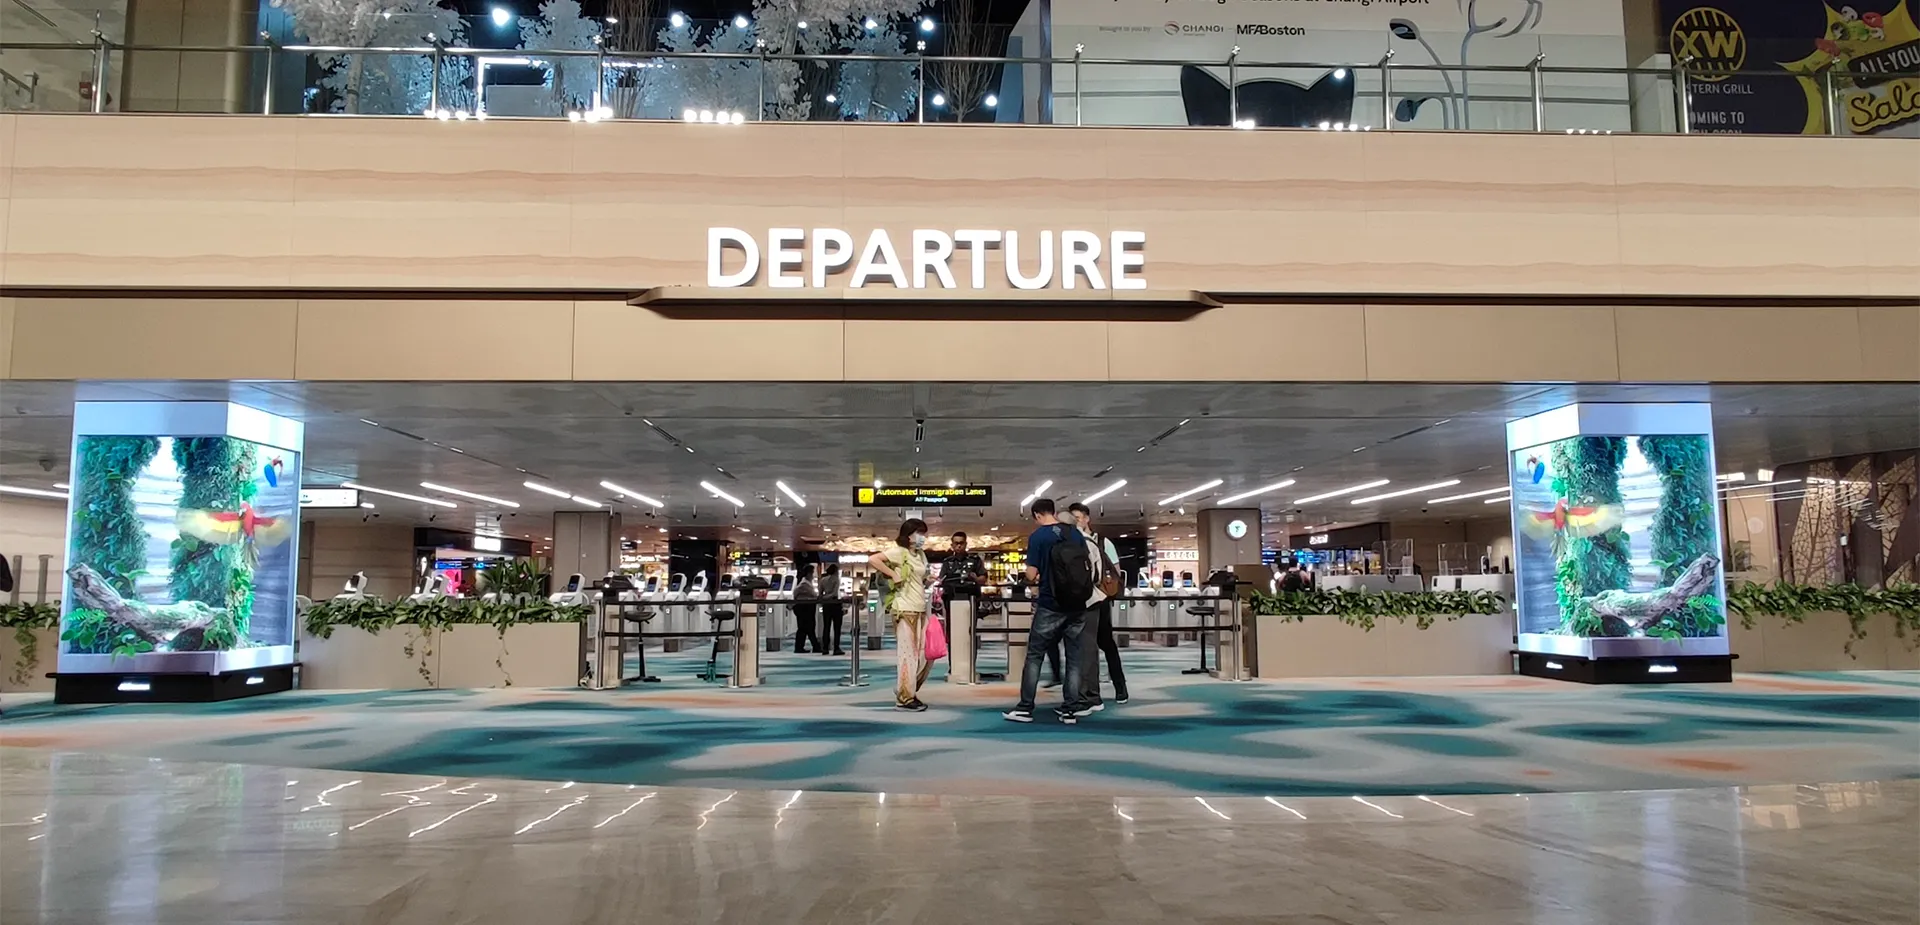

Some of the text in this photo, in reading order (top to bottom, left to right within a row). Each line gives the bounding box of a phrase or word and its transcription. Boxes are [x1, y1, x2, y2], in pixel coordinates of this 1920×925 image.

[1675, 31, 1739, 58] XW
[1722, 83, 1754, 94] GRILL
[1689, 111, 1745, 124] OMING TO
[707, 227, 1147, 290] DEPARTURE
[876, 488, 987, 497] Automated Immigration Lanes
